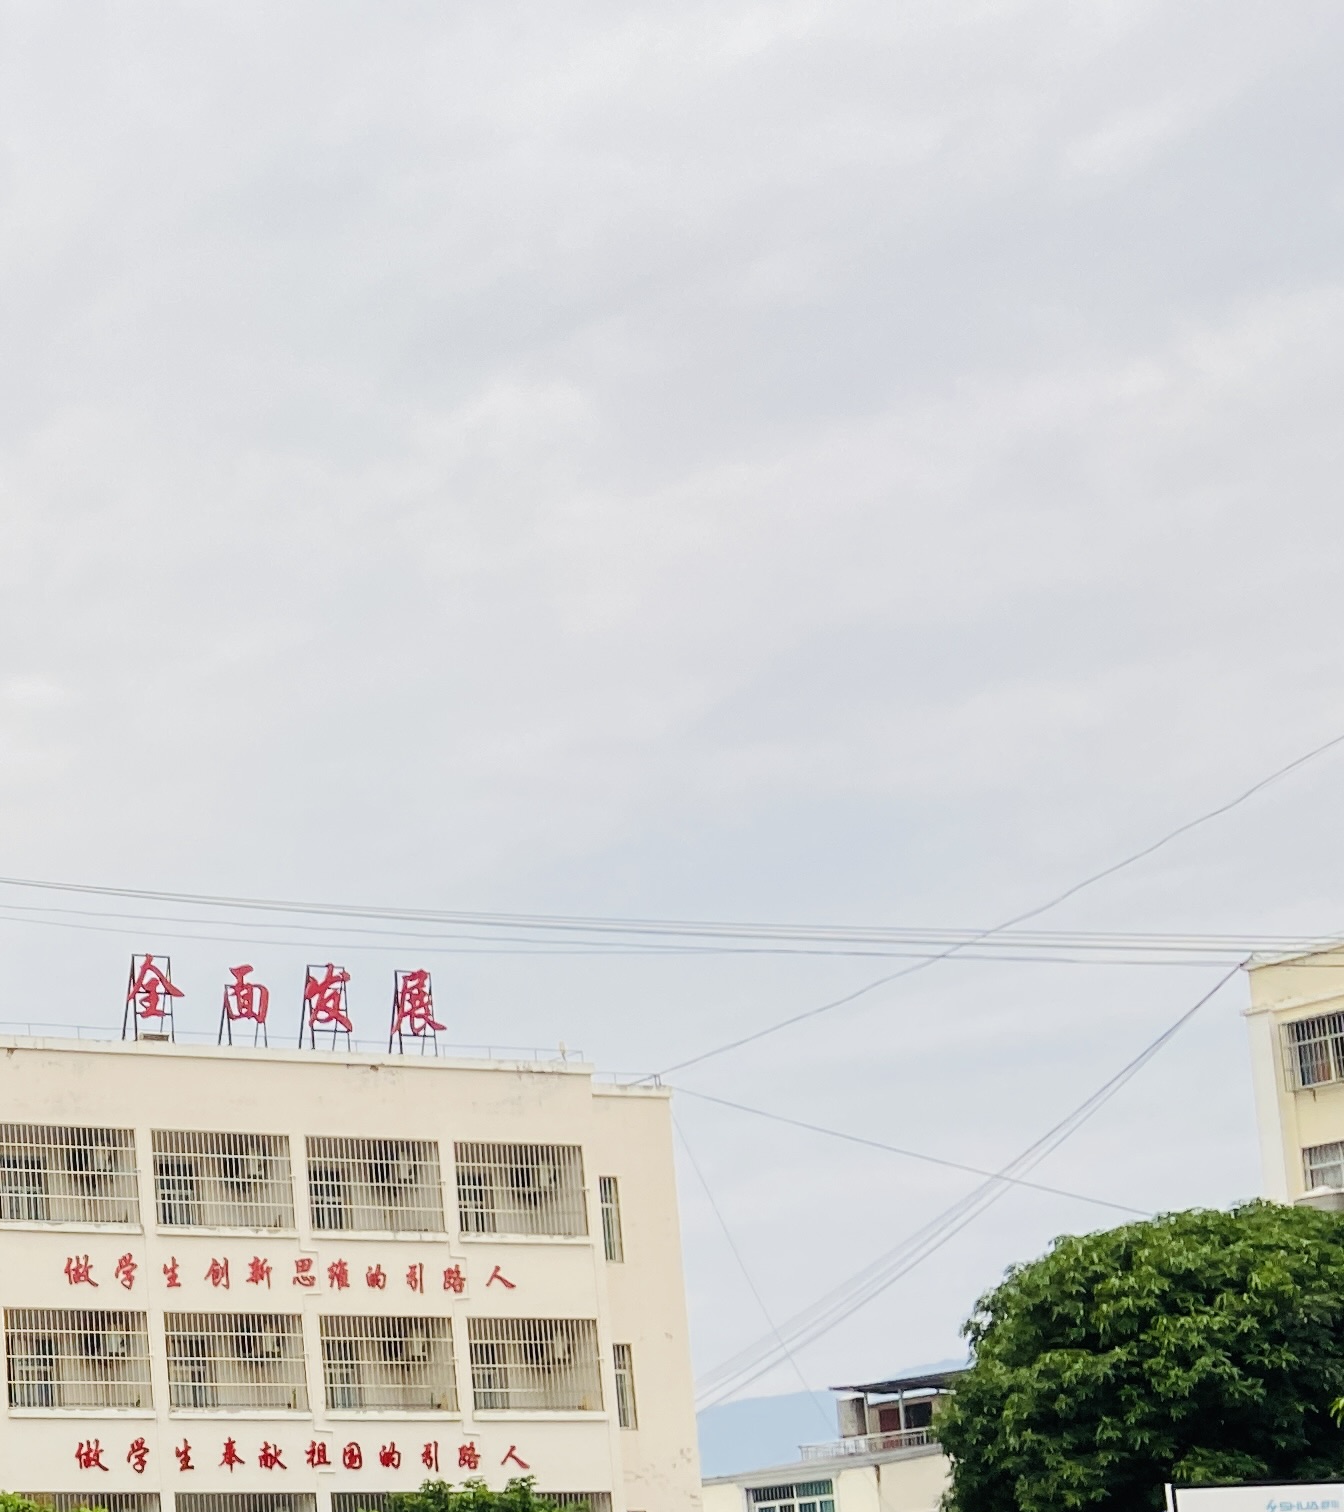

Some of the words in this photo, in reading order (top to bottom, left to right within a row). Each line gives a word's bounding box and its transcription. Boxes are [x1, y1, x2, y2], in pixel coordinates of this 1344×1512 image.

[127, 954, 447, 1035] 全面发展
[64, 1252, 516, 1293] 做学生创新思维的引路人
[75, 1436, 529, 1473] 做学生奉献祖国的引路人
